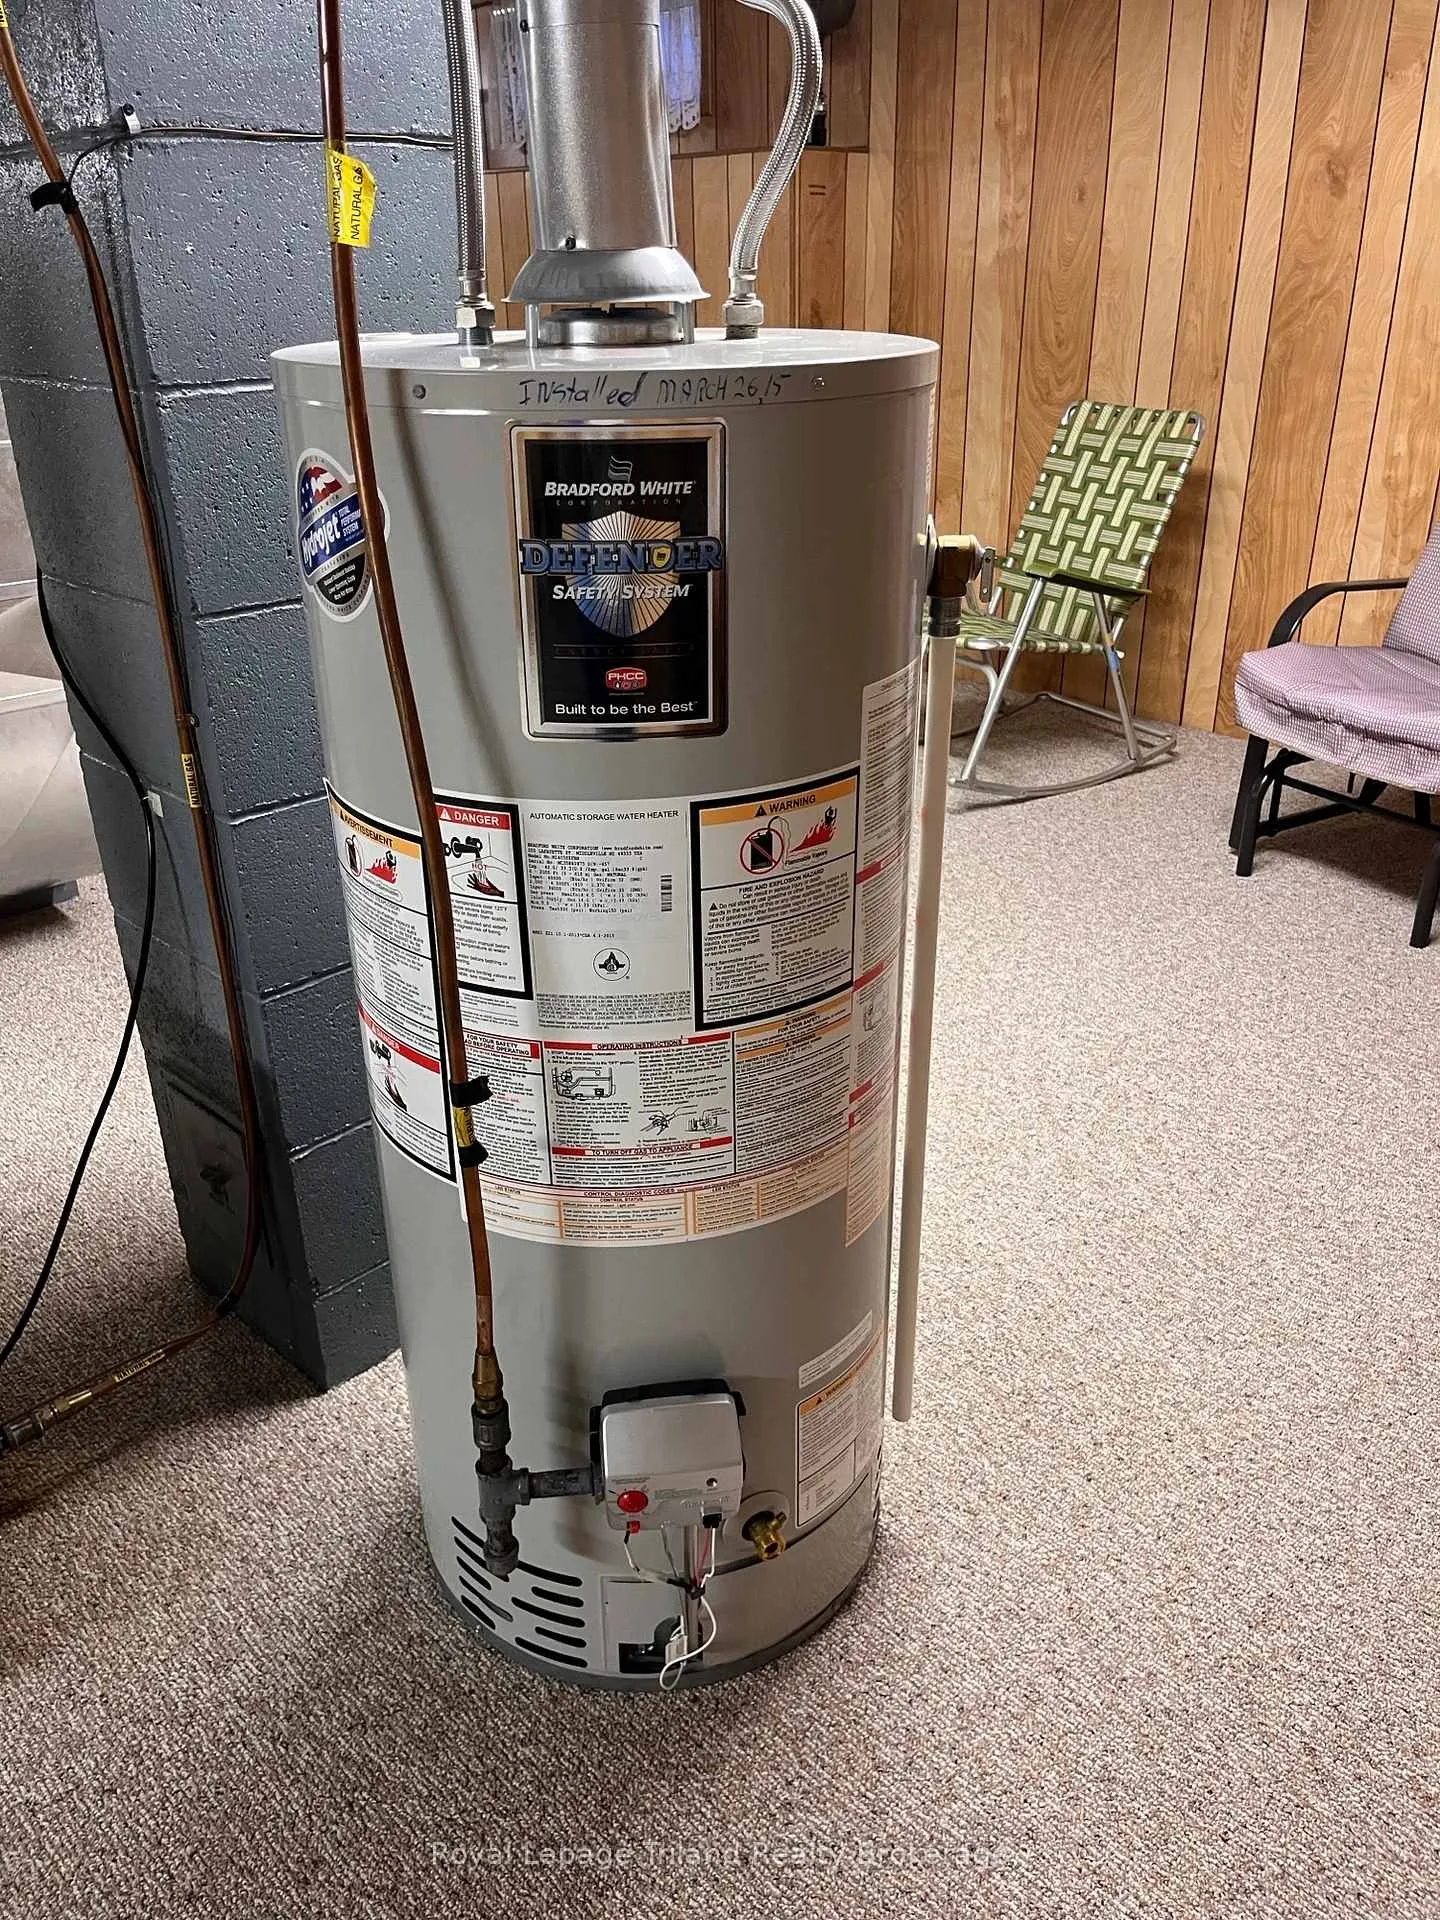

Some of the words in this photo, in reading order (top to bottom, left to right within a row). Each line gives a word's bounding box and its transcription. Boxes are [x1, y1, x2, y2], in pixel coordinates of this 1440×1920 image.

[351, 187, 363, 240] NATURAL
[544, 481, 635, 496] BRADFORD
[640, 480, 694, 495] WHITE
[343, 521, 358, 537] SYSTEM
[301, 513, 340, 568] Hydrojet
[519, 536, 723, 575] DEFENDER
[552, 584, 618, 600] SAFETY
[622, 583, 690, 599] SYSTEM
[608, 672, 644, 681] PHCC
[555, 703, 587, 715] Built
[591, 704, 605, 715] to
[609, 703, 629, 715] be
[633, 703, 656, 714] the
[661, 701, 694, 713] Best
[769, 794, 816, 813] WARNING
[454, 811, 500, 826] DANGER
[529, 812, 575, 820] AUTOMATIC
[577, 813, 615, 821] STORAGE
[616, 812, 645, 820] WATER
[647, 810, 679, 819] HEATER
[471, 863, 488, 871] HOT
[739, 886, 755, 895] FIRE
[755, 882, 768, 891] AND
[769, 875, 801, 888] EXPLOSION
[802, 868, 825, 880] HAZARD
[789, 1021, 803, 1030] YOUR
[473, 1040, 495, 1049] BEFORE
[496, 1046, 530, 1056] OPERATING
[479, 1036, 495, 1045] YOUR
[495, 1040, 518, 1049] SAFETY
[597, 1042, 635, 1050] OPERATING
[635, 1039, 682, 1050] INSTRUCTIONS
[632, 1148, 647, 1156] GAS
[659, 1145, 693, 1153] APPLIANCE
[614, 1188, 652, 1197] DIAGNOSTIC
